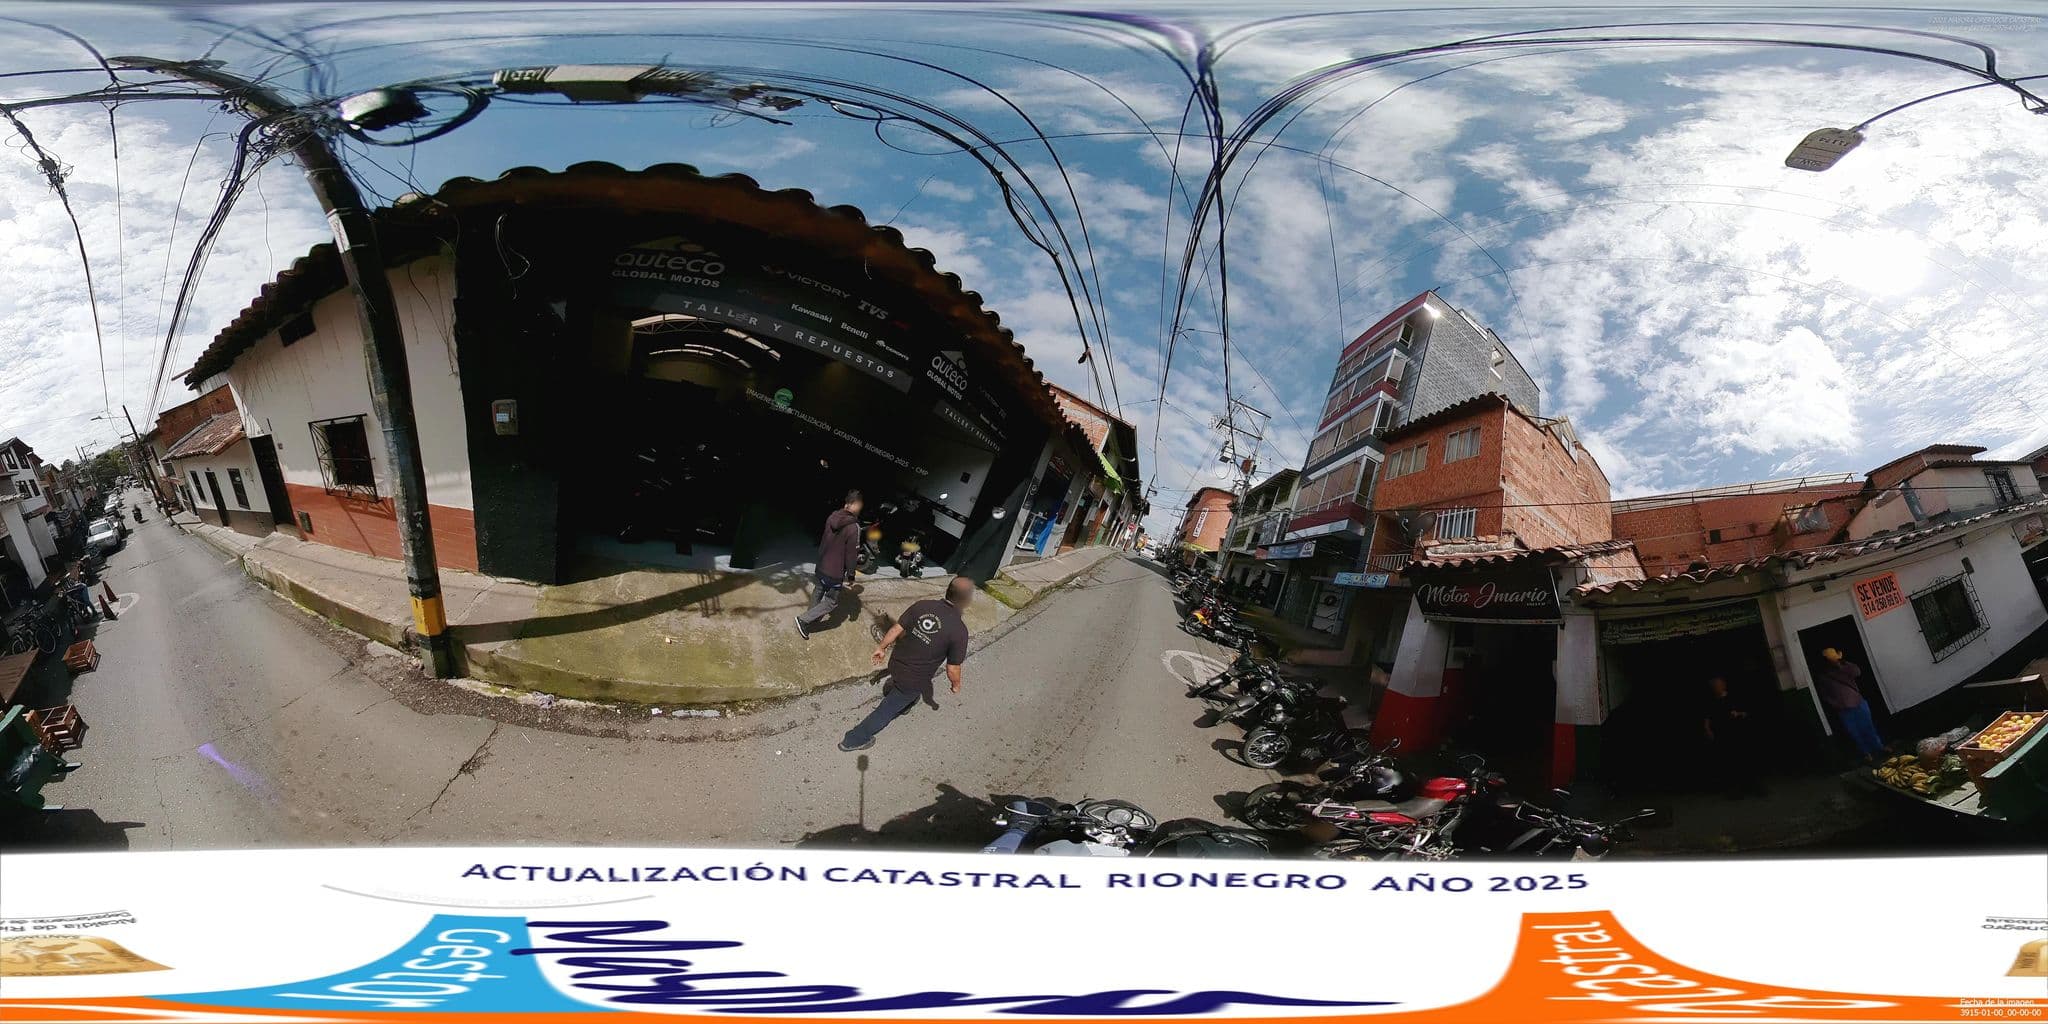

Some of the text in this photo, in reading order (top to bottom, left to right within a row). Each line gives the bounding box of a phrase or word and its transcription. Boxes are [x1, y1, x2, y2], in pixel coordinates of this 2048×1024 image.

[614, 252, 725, 275] auteco
[612, 270, 721, 288] GLOBAL MOTOS
[787, 271, 851, 299] VICTORY
[791, 303, 833, 325] Kawasaki
[857, 299, 889, 320] TVS
[840, 321, 869, 341] Benelli
[772, 322, 783, 333] Y
[794, 330, 895, 379] REPUESTOS
[1418, 583, 1471, 607] Motos
[1857, 575, 1897, 602] SE VENDE
